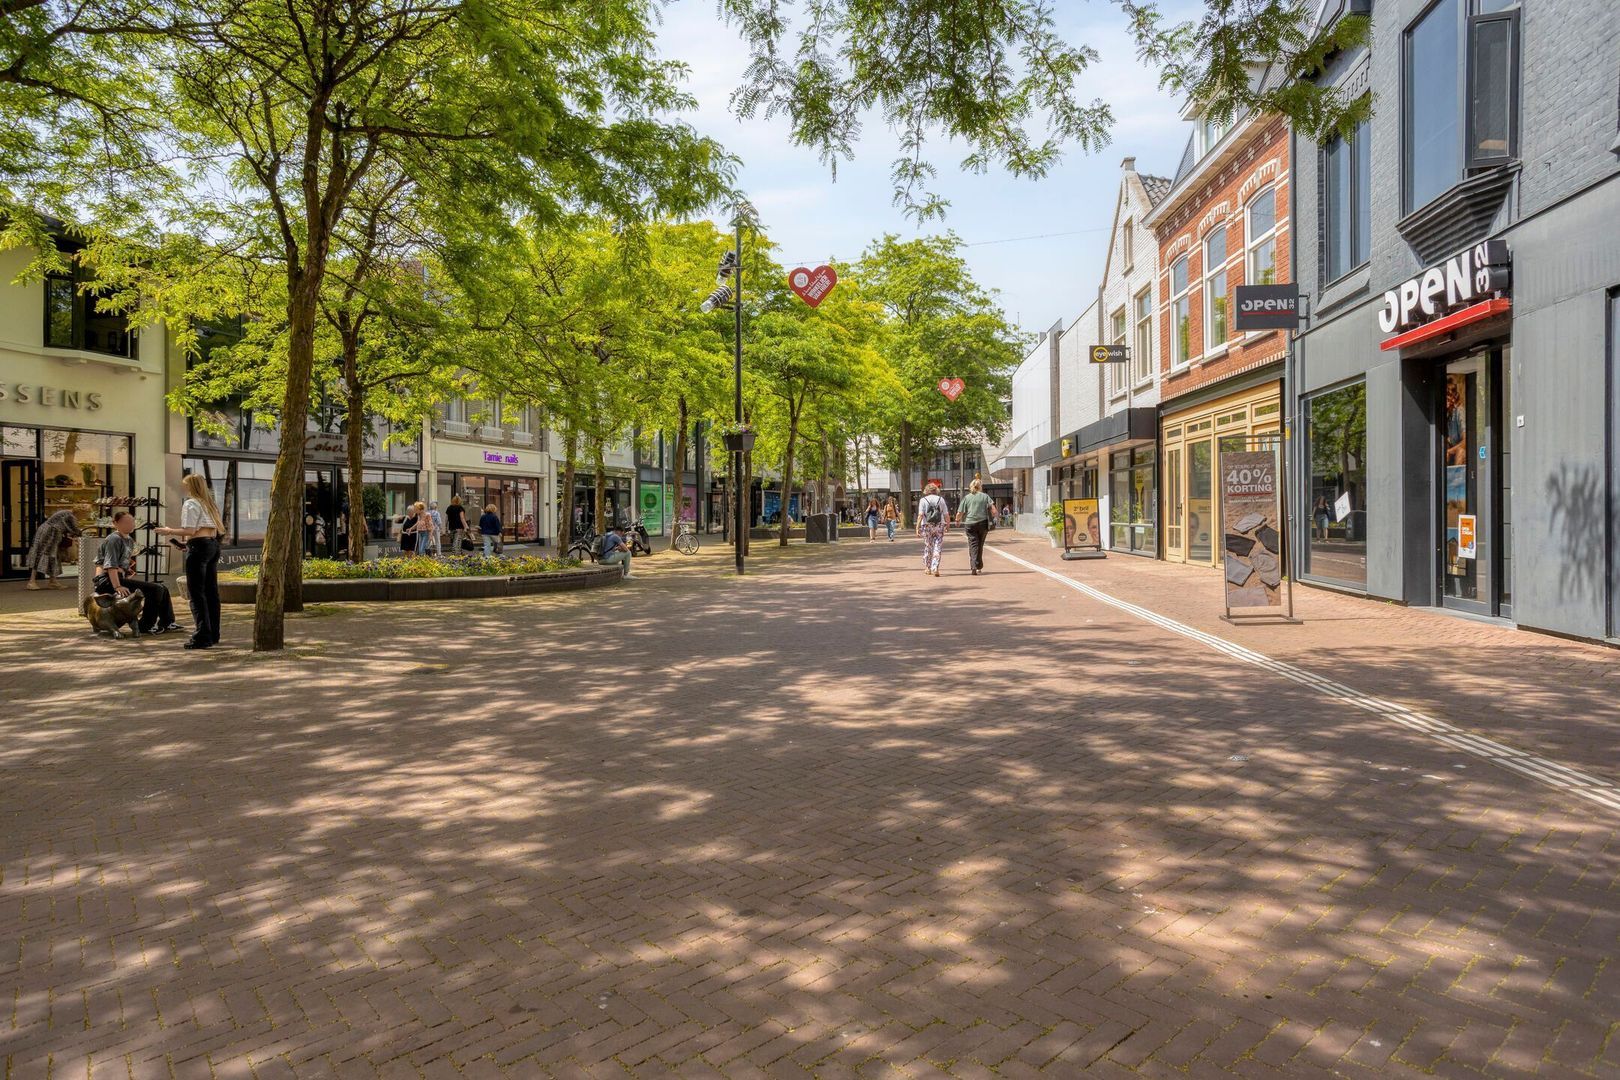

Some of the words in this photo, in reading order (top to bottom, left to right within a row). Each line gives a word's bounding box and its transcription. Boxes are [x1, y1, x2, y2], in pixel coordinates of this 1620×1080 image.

[1474, 240, 1489, 294] 32
[1288, 298, 1295, 309] 32
[505, 453, 519, 464] nails
[1226, 468, 1272, 485] 40%
[1227, 484, 1272, 493] KORTING
